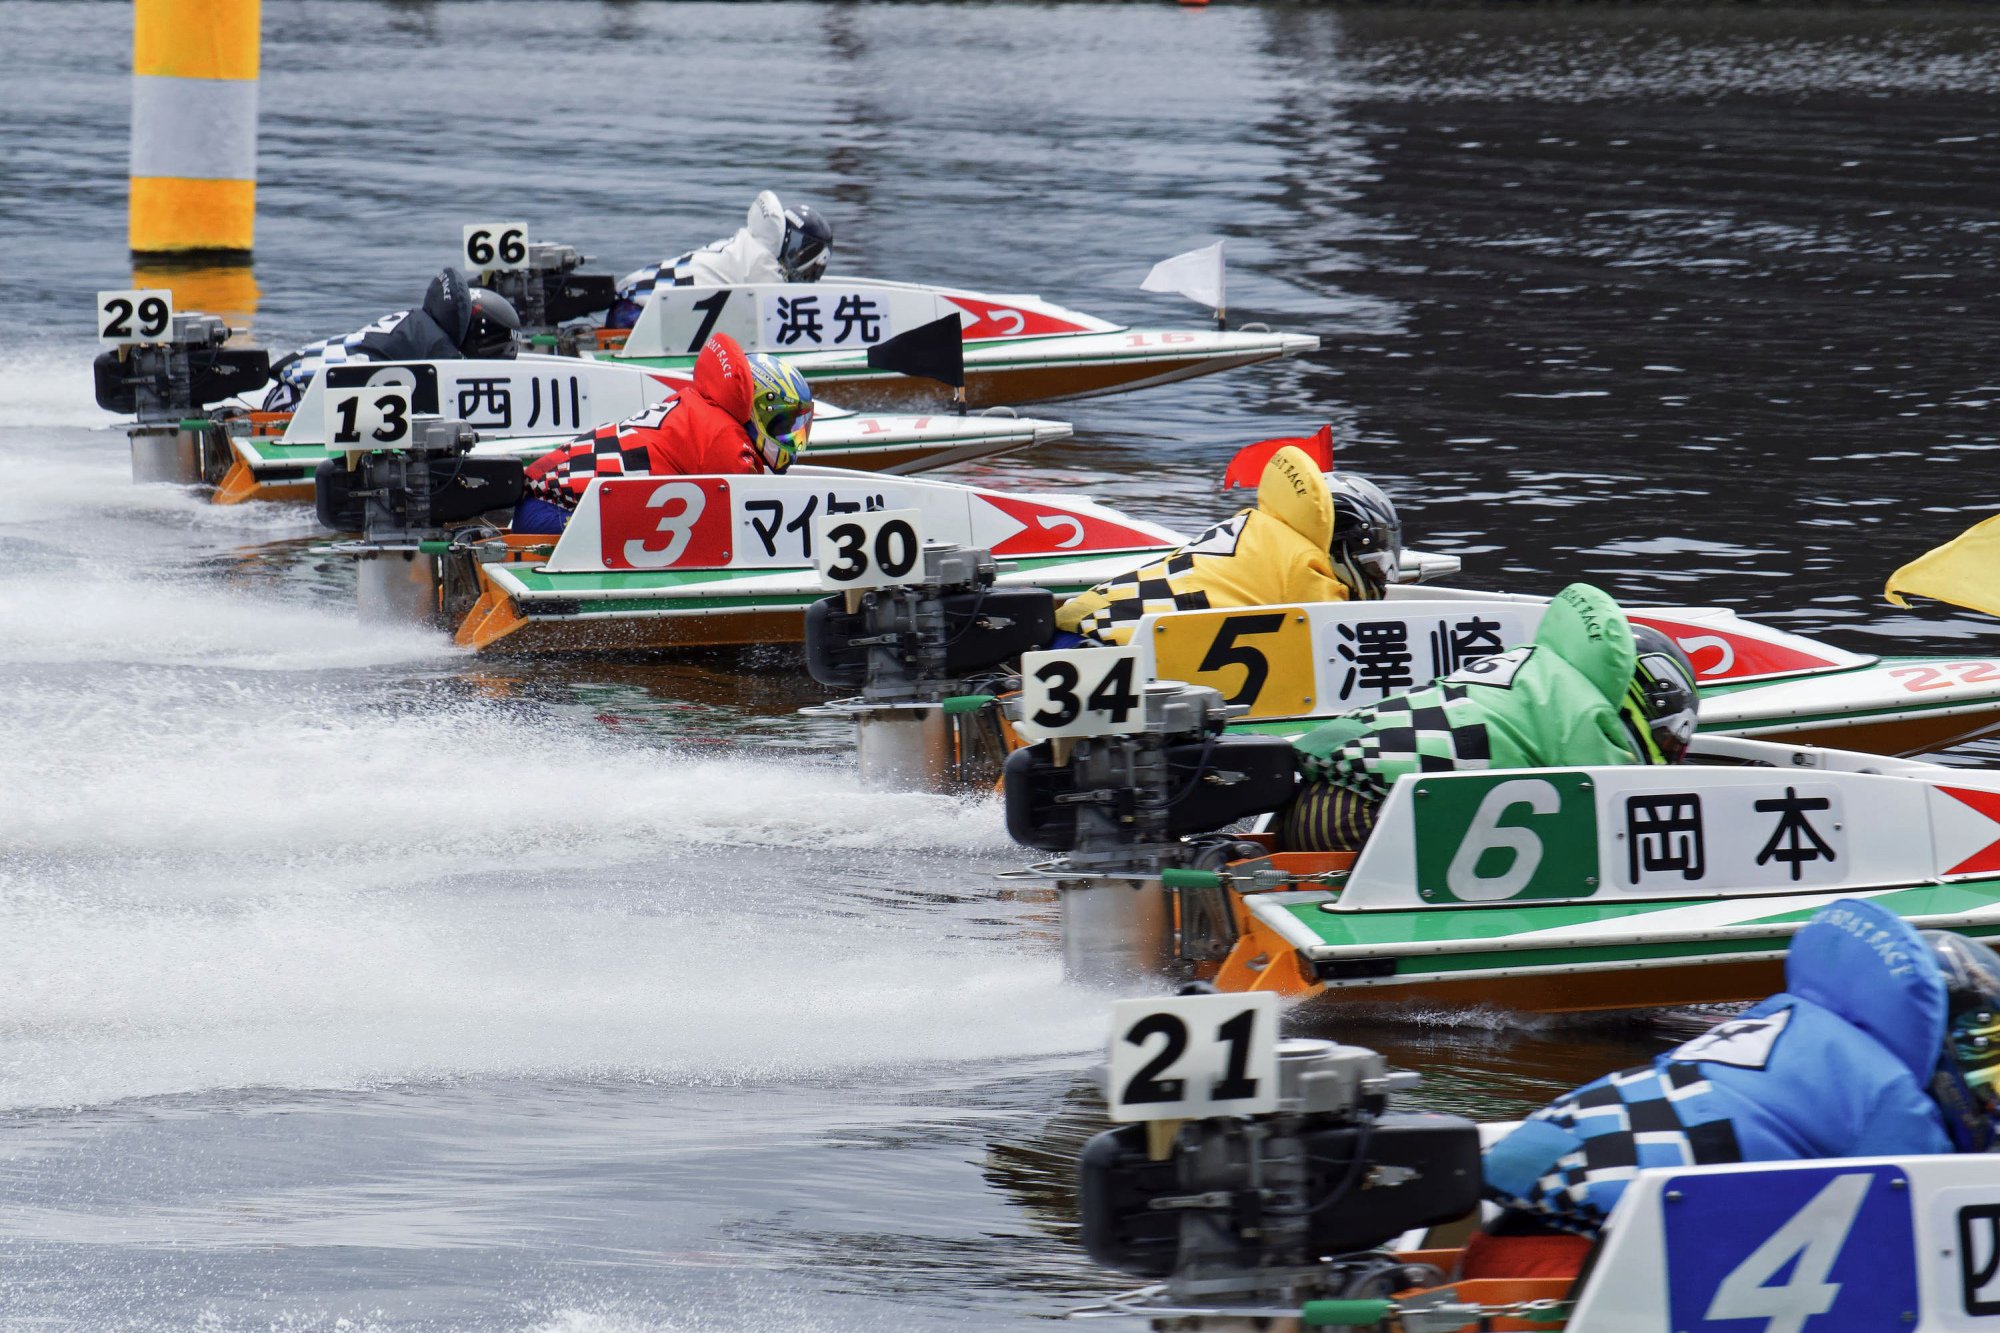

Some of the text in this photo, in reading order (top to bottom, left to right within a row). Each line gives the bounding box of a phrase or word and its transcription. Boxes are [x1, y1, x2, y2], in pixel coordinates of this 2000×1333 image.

[467, 229, 526, 265] 66
[103, 298, 169, 338] 29
[687, 290, 732, 353] 1
[776, 294, 881, 345] 浜先
[1126, 332, 1196, 348] 16
[333, 394, 409, 444] 13
[455, 376, 580, 430] 西川
[861, 416, 932, 435] 17
[622, 481, 706, 569] 3
[827, 519, 918, 582] 30
[1197, 613, 1287, 707] 5
[1889, 662, 2000, 692] 22
[1031, 655, 1140, 729] 34
[1448, 779, 1561, 901] 6
[1625, 786, 1837, 883] 岡本
[1120, 1008, 1260, 1106] 21
[1702, 1172, 1876, 1333] 4
